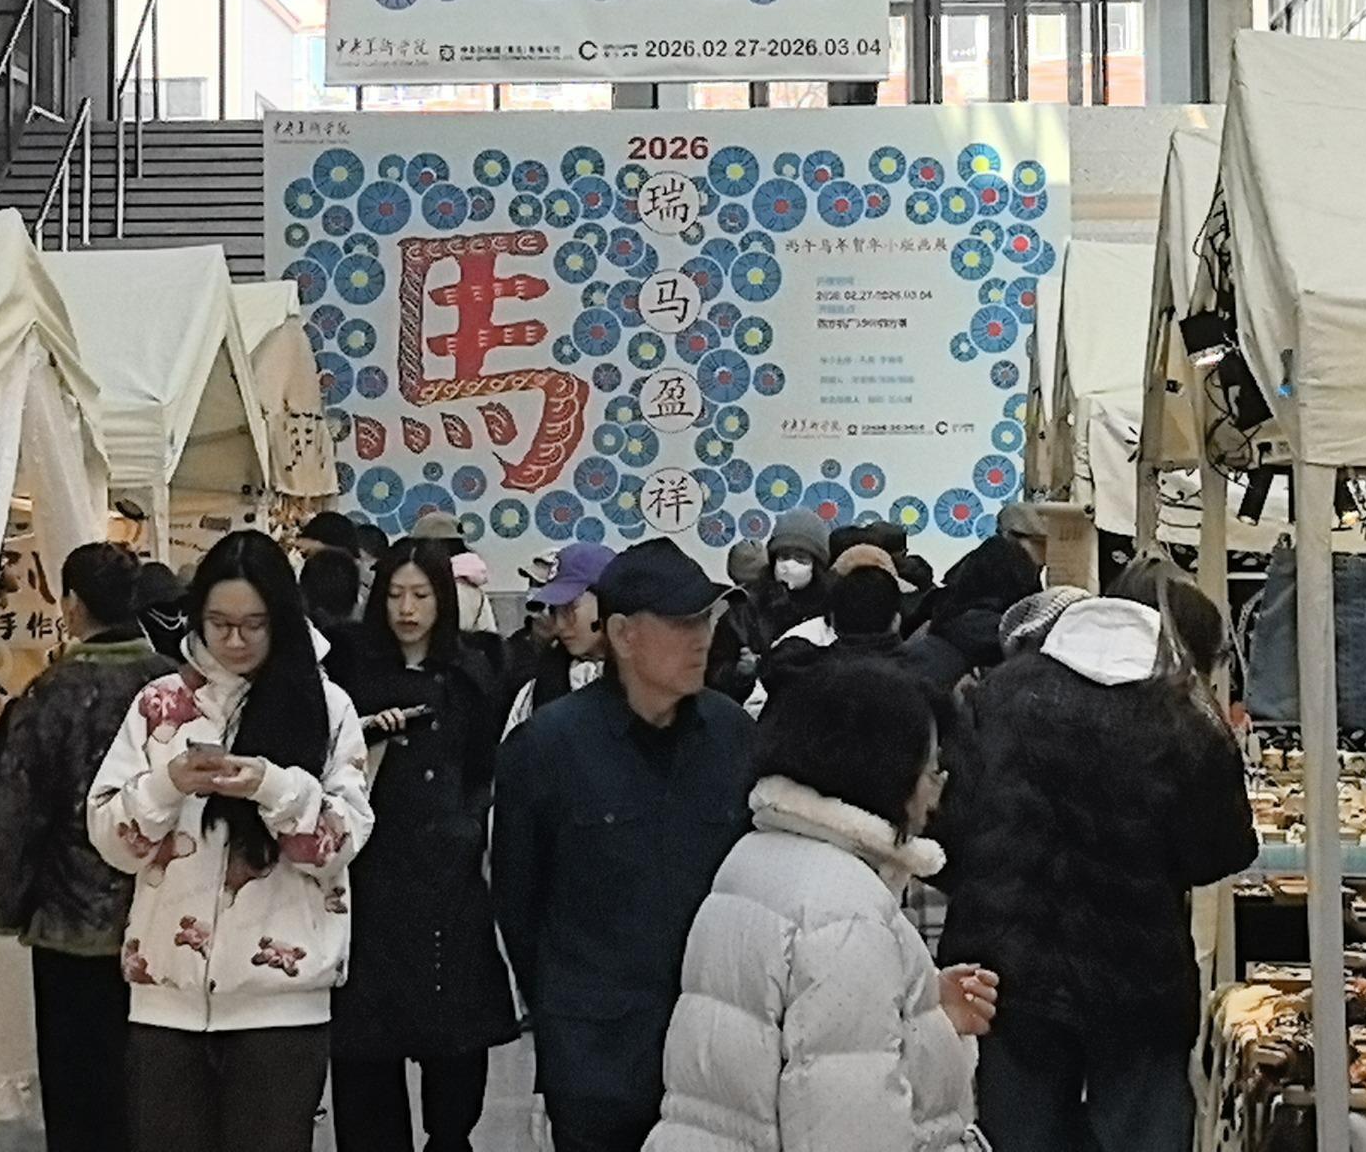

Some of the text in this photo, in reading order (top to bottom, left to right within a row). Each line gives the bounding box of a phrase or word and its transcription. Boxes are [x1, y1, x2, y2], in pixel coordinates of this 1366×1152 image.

[644, 38, 882, 59] 2026.02.27-2026.03.04
[627, 136, 710, 160] 2026
[643, 176, 695, 524] 瑞马盈祥
